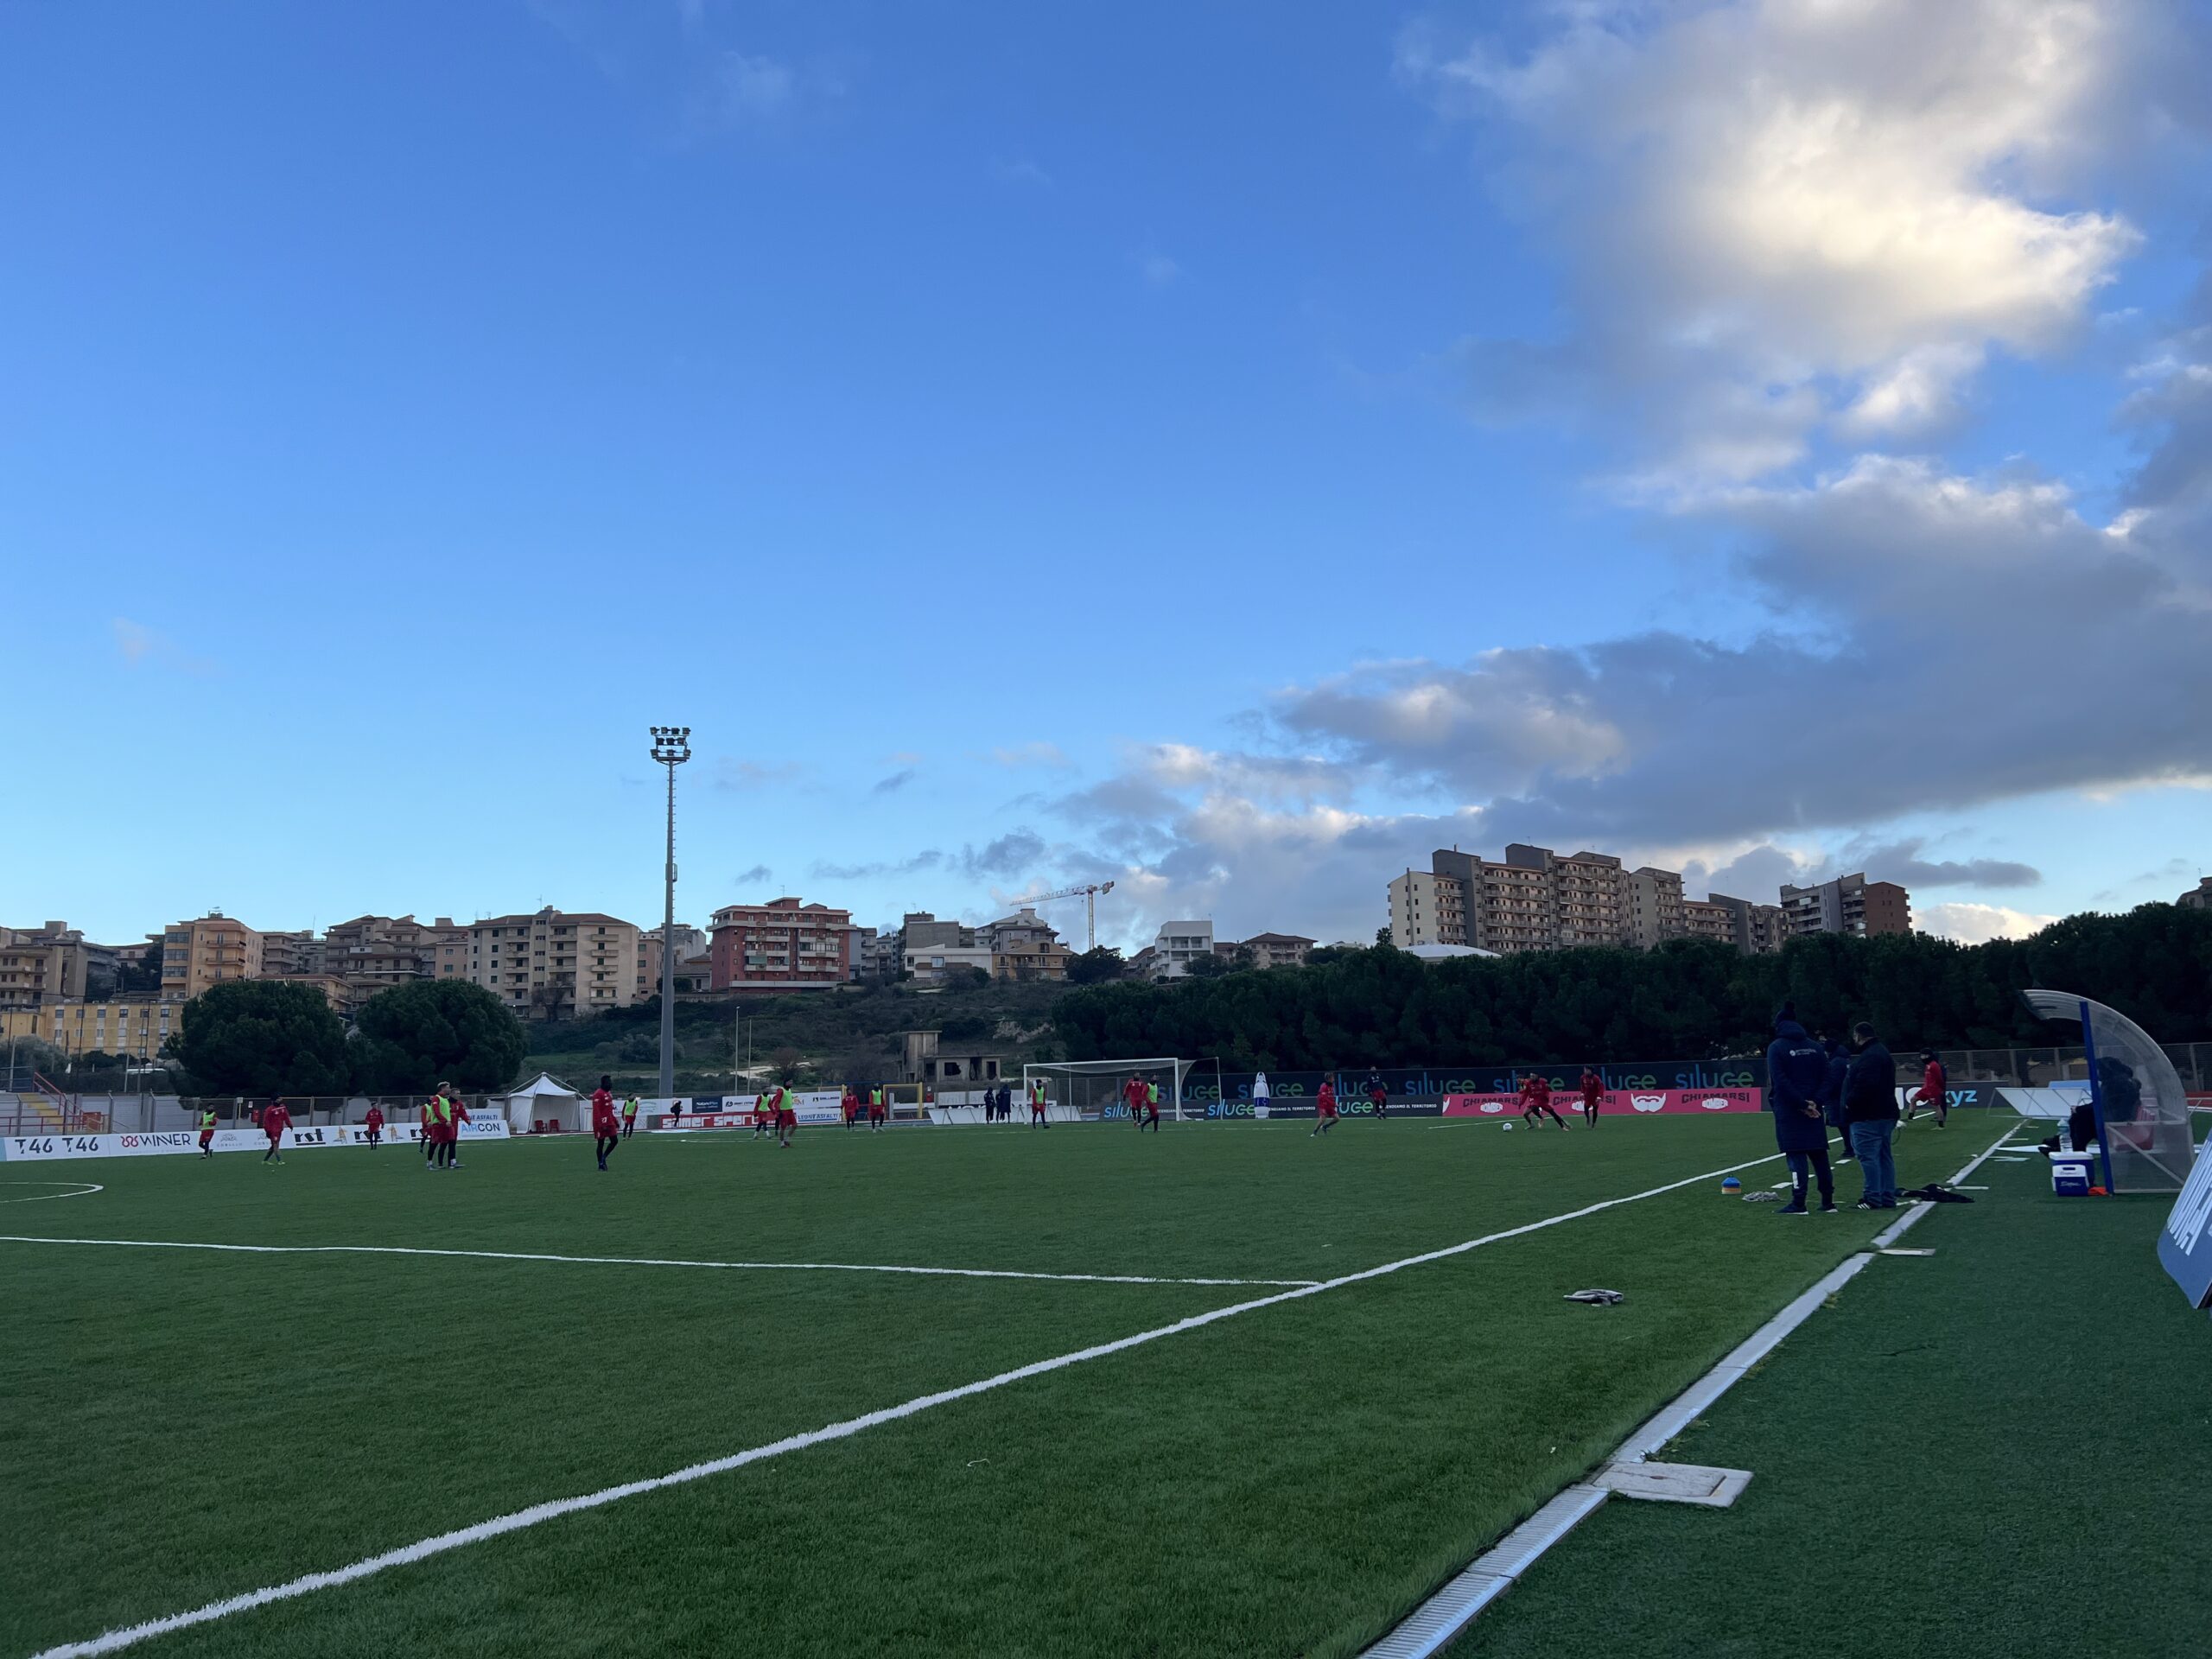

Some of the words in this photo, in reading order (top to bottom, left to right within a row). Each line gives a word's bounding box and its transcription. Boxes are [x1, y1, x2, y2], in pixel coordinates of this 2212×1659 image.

[1405, 1072, 1477, 1095] siluce
[1675, 1064, 1755, 1090] siluce
[1463, 1096, 1522, 1107] CHIAMARS
[461, 1122, 501, 1133] AIRCON
[139, 1133, 191, 1147] WINNER
[294, 1128, 324, 1141] rst
